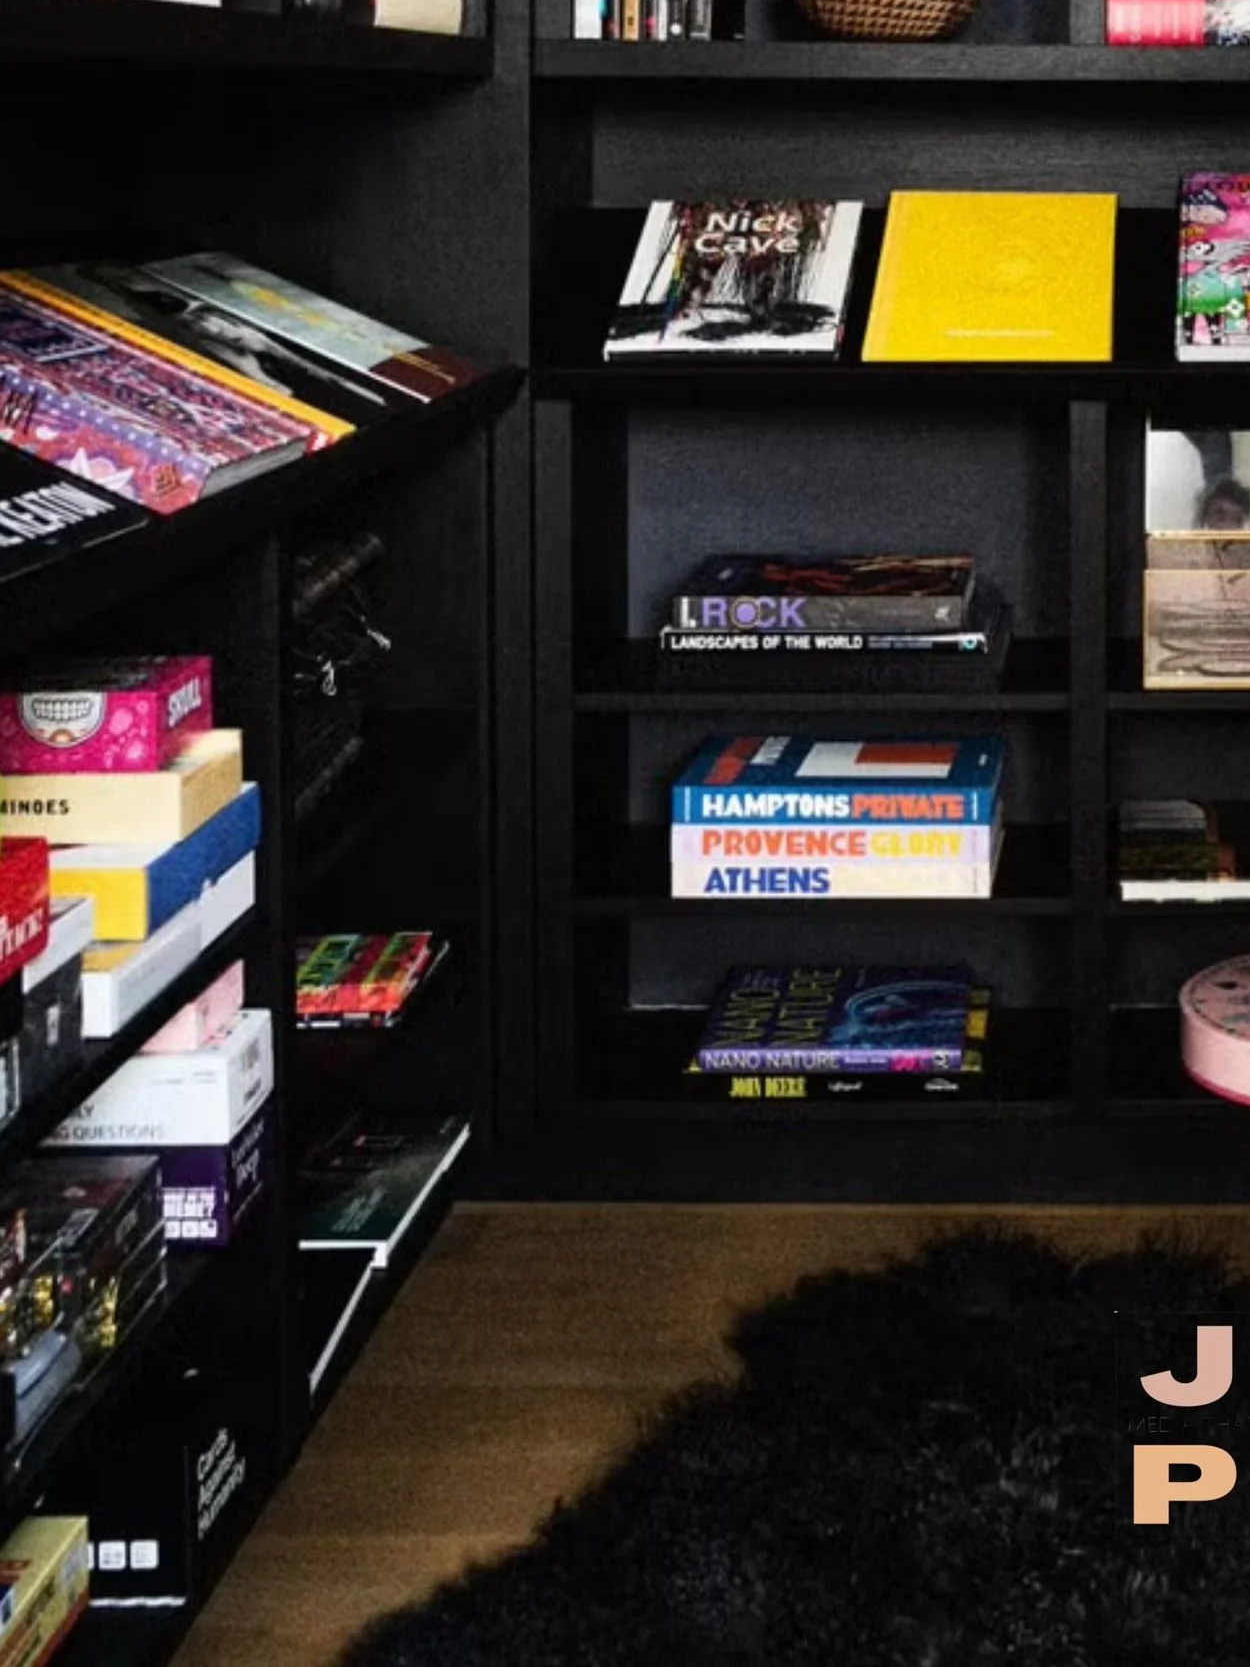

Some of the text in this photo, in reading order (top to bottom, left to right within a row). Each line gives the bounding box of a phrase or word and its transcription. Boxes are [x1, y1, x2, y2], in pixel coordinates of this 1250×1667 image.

[706, 211, 798, 232] Nick
[695, 232, 800, 253] Cave
[671, 635, 863, 649] LANDSCAPES OF THE WORLD
[702, 793, 965, 819] HAMPTONS PRIVATE
[702, 829, 963, 856] PROVENCE GLORY
[704, 867, 831, 893] ATHENS
[704, 1051, 841, 1069] NANO NATURE
